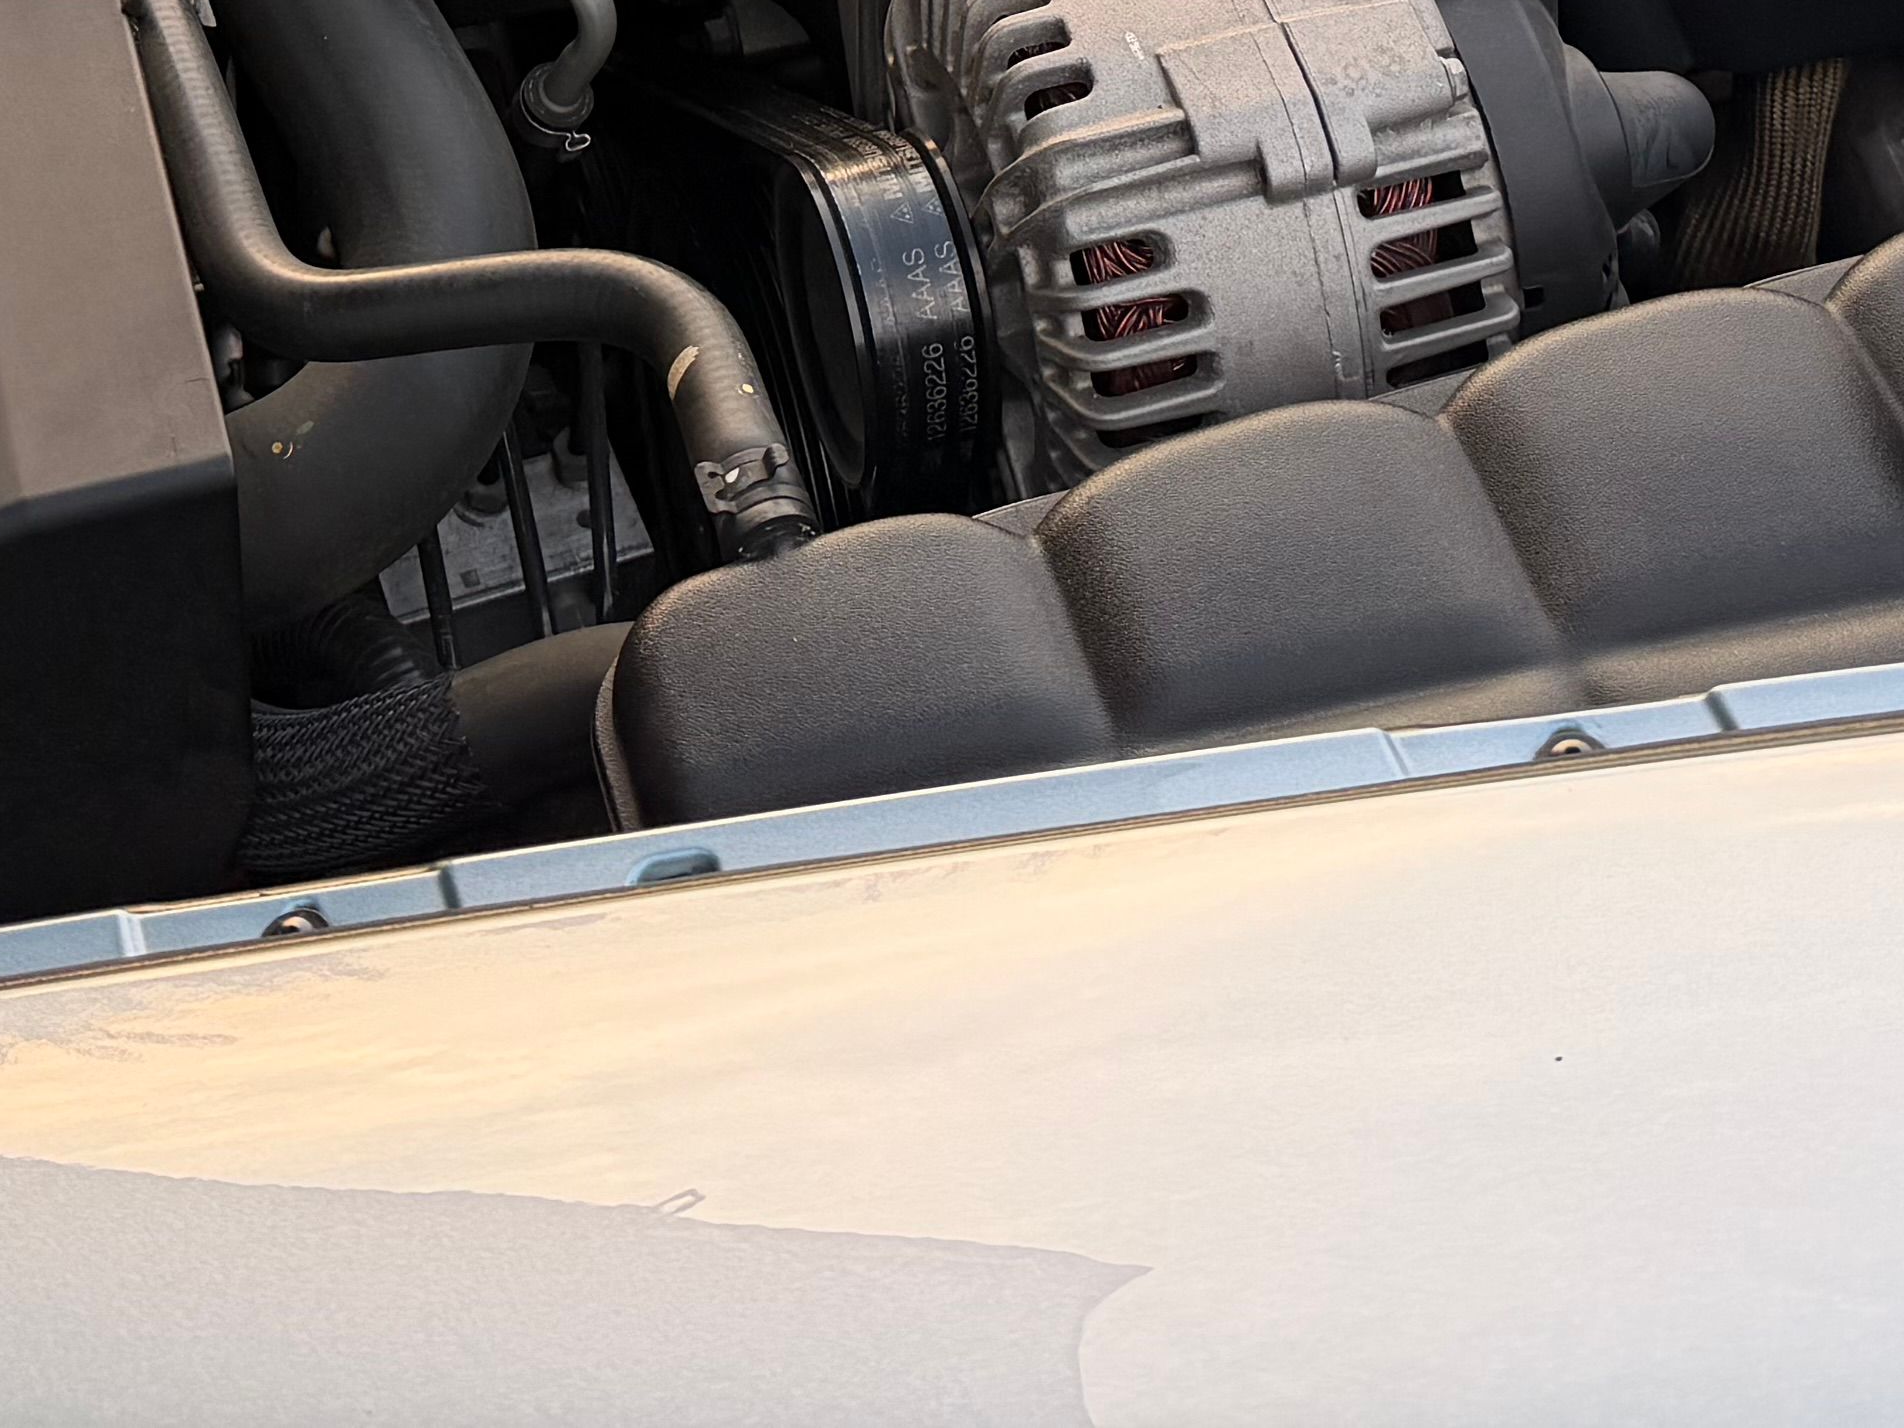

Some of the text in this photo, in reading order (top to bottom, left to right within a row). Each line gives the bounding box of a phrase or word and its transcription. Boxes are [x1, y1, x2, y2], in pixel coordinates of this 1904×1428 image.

[902, 247, 938, 320] AAAS
[934, 240, 971, 313] AAAS
[922, 342, 947, 441] 12636226
